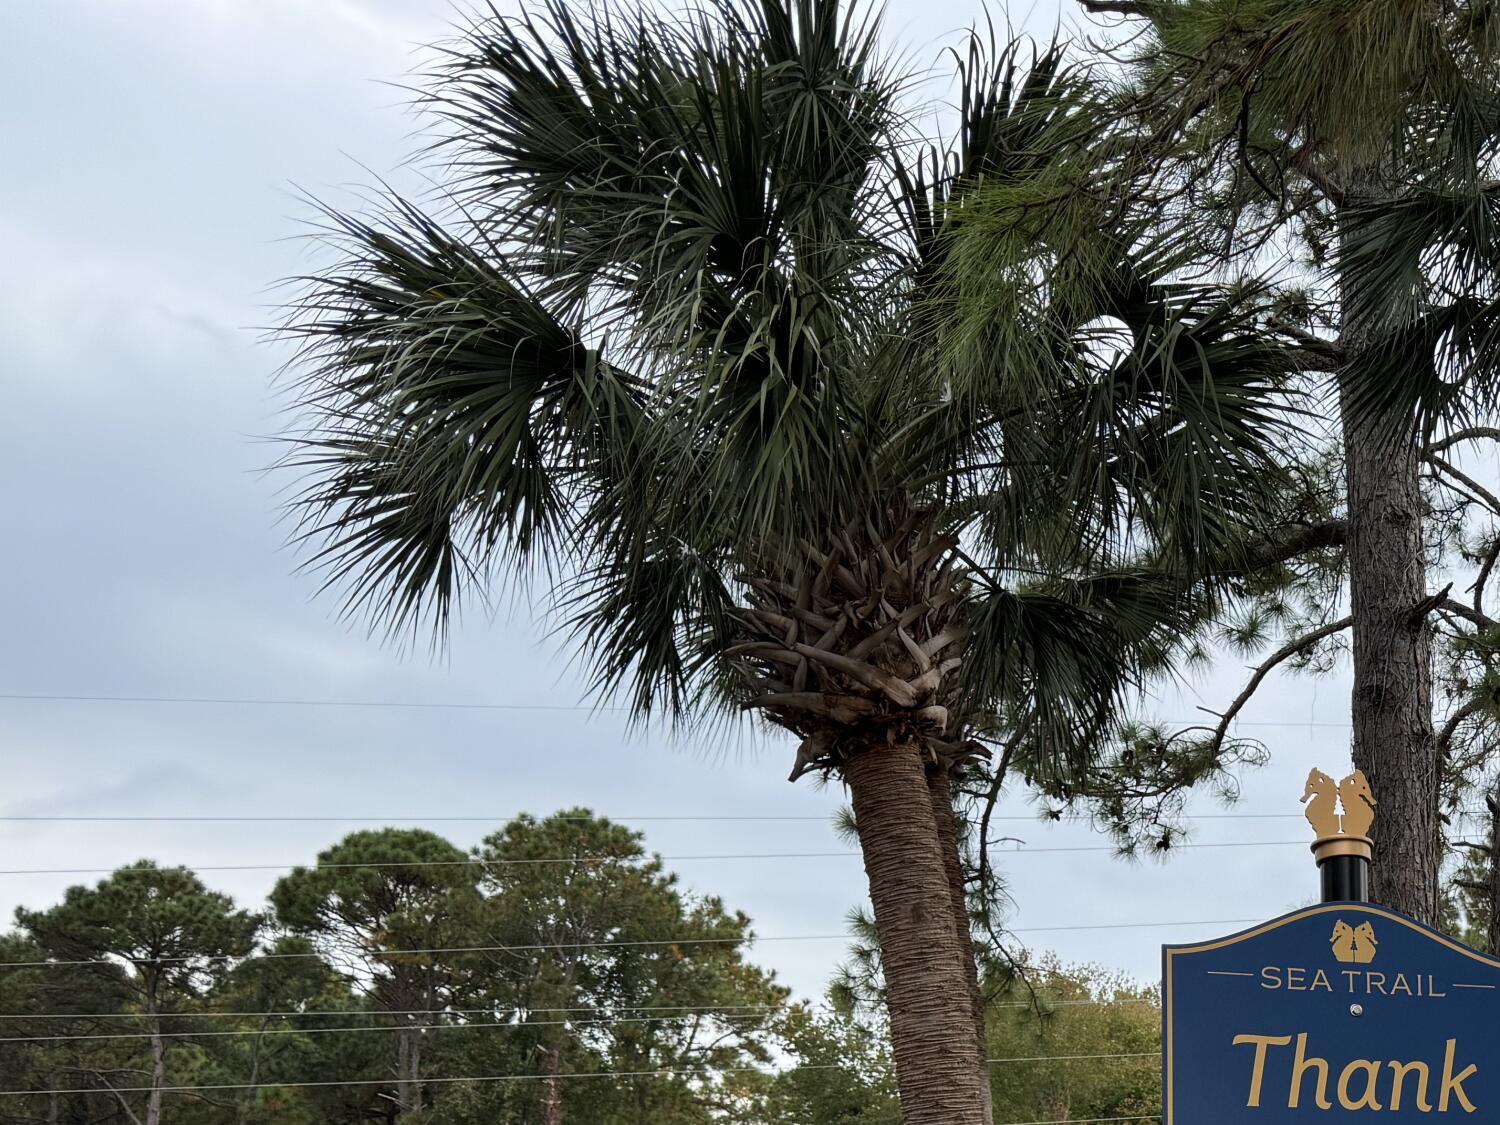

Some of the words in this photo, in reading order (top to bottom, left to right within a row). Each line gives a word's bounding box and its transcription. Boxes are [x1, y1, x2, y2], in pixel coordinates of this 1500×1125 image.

[1260, 966, 1333, 992] SEA
[1341, 970, 1446, 998] TRAIL
[1232, 1032, 1478, 1113] Thank
